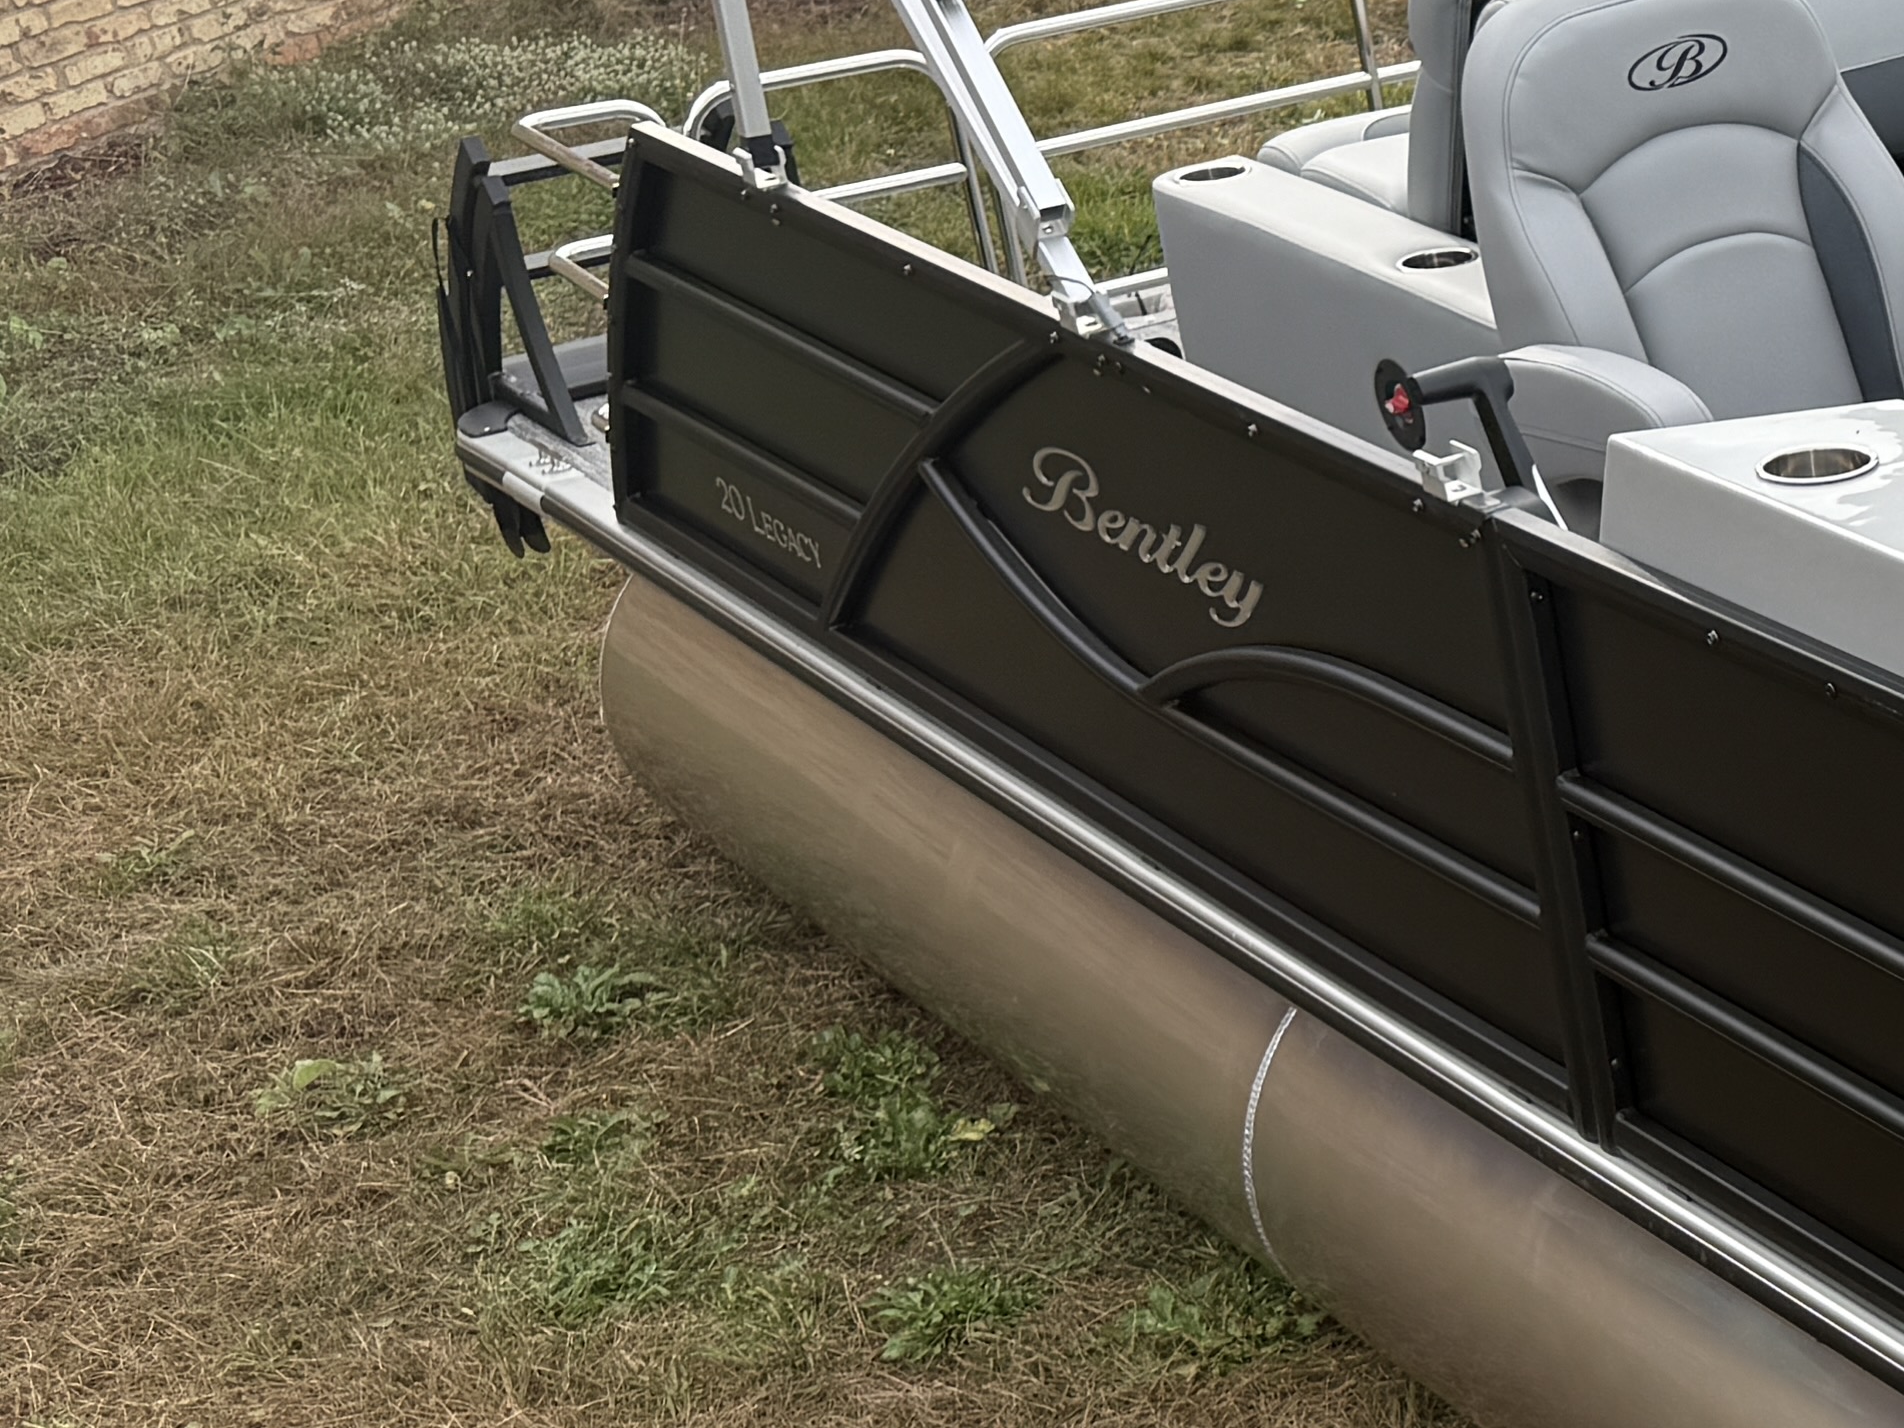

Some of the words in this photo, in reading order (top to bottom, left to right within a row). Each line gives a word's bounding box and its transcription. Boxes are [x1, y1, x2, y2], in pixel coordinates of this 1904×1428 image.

[715, 477, 745, 521] 20
[746, 495, 822, 569] LEGACY
[1022, 446, 1264, 628] Bentley
